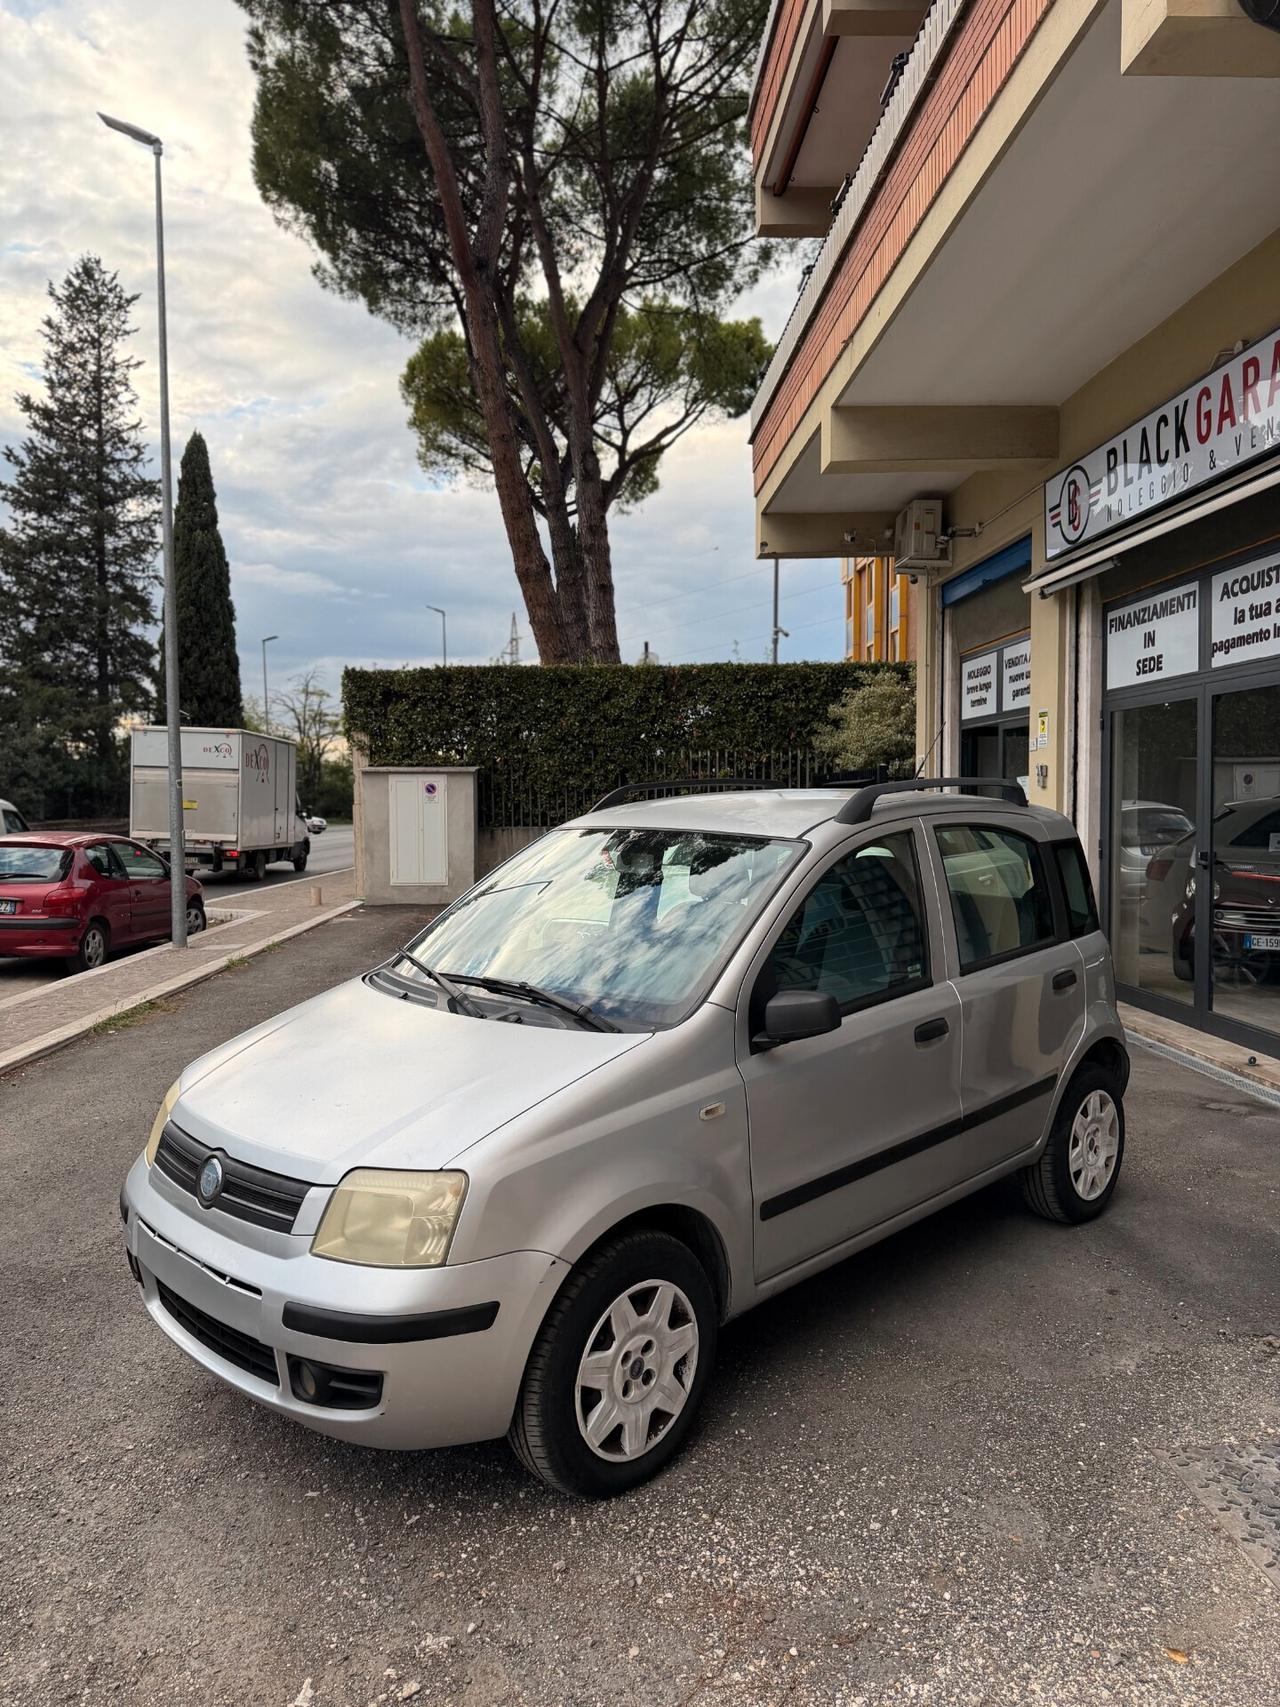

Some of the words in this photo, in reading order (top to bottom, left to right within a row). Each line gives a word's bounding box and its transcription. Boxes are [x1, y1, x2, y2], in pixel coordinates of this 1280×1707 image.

[1106, 462, 1190, 522] NOLEGGIO
[1209, 450, 1217, 470] &
[1109, 590, 1197, 634] FINANZIAMENTI
[1233, 606, 1246, 625] la
[1249, 602, 1272, 620] tua
[1143, 630, 1156, 649] IN
[1211, 627, 1271, 658] pagamento
[1136, 654, 1164, 676] SEDE
